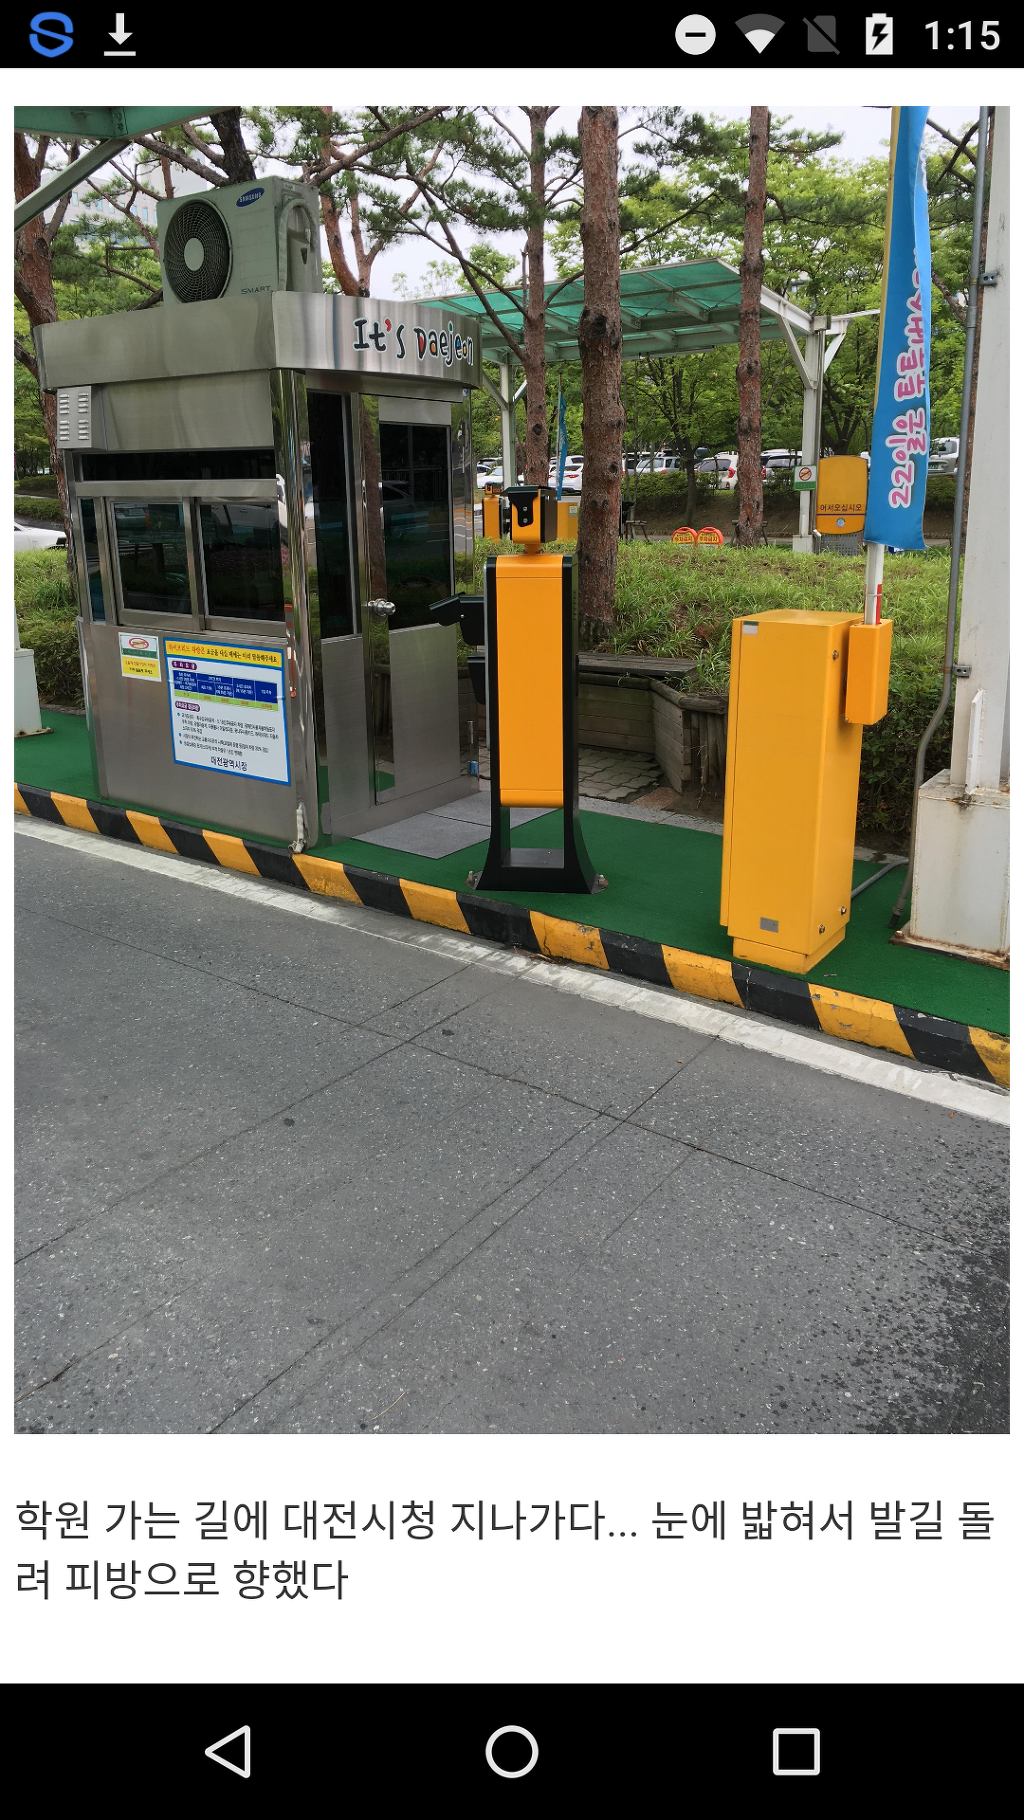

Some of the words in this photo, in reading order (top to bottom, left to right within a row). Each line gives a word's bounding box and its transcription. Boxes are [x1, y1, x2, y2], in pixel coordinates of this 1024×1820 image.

[239, 191, 262, 203] SAMSUNG
[241, 285, 271, 295] SMART
[353, 316, 406, 360] It's
[413, 320, 474, 367] Daejeon
[886, 410, 926, 506] 22일은
[820, 503, 862, 512] 어서오십시오
[210, 756, 248, 772] 대전광역시장
